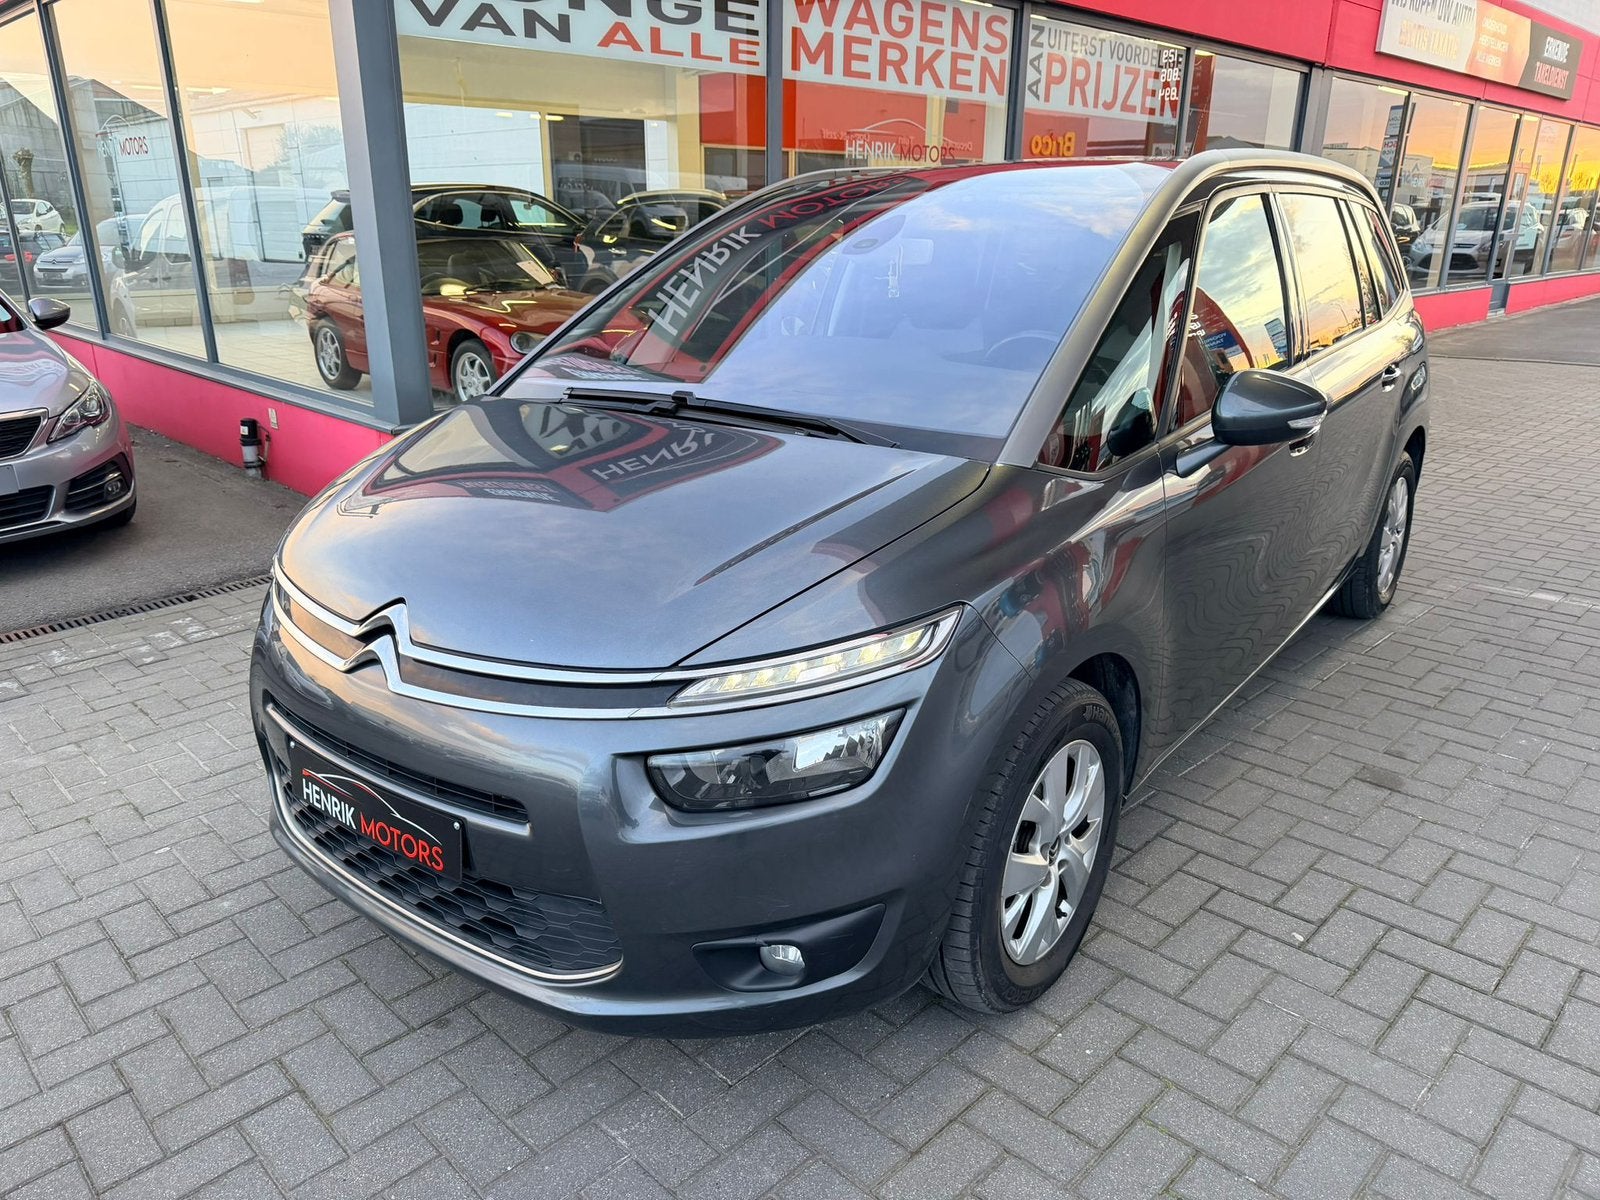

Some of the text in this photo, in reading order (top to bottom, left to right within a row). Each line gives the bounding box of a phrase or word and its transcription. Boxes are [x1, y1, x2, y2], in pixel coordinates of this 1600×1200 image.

[409, 0, 1006, 96] VAN ALLE MERKEN
[793, 0, 1008, 54] WAGENS
[1048, 27, 1106, 57] UITERST
[1027, 24, 1045, 101] AAN
[1043, 52, 1181, 119] PRIJZEN
[845, 139, 896, 161] HENRIK
[900, 144, 956, 163] MOTORS
[302, 778, 445, 872] HENRIK MOTORS
